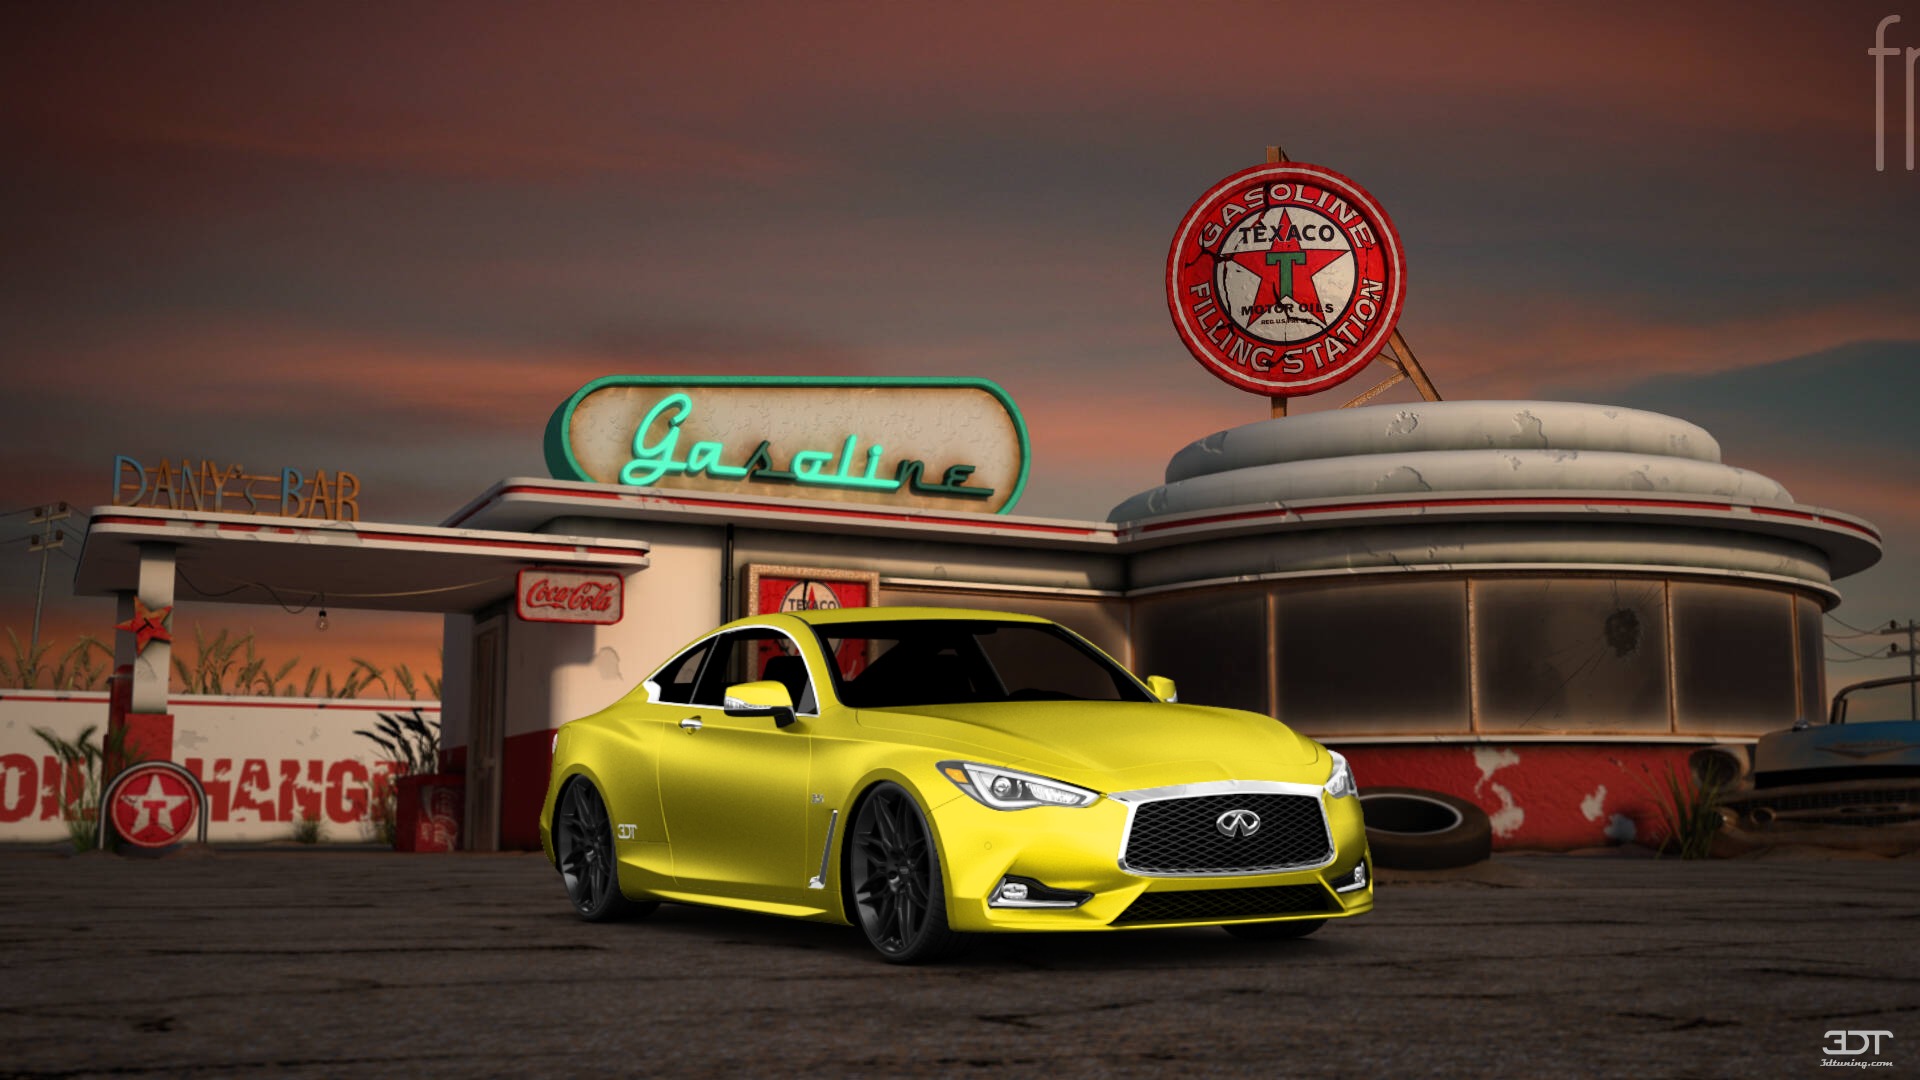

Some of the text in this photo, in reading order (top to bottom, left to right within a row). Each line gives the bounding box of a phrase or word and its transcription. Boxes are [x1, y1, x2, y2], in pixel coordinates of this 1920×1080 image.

[1198, 183, 1376, 249] GASOLINE
[1239, 224, 1335, 244] TEXACO
[1190, 277, 1385, 374] FILLING STATION
[1241, 303, 1334, 316] MOTOR OILS
[619, 393, 995, 498] Gasoline
[281, 466, 360, 522] BAR
[787, 598, 837, 611] TEXACO
[617, 823, 638, 840] 3DT
